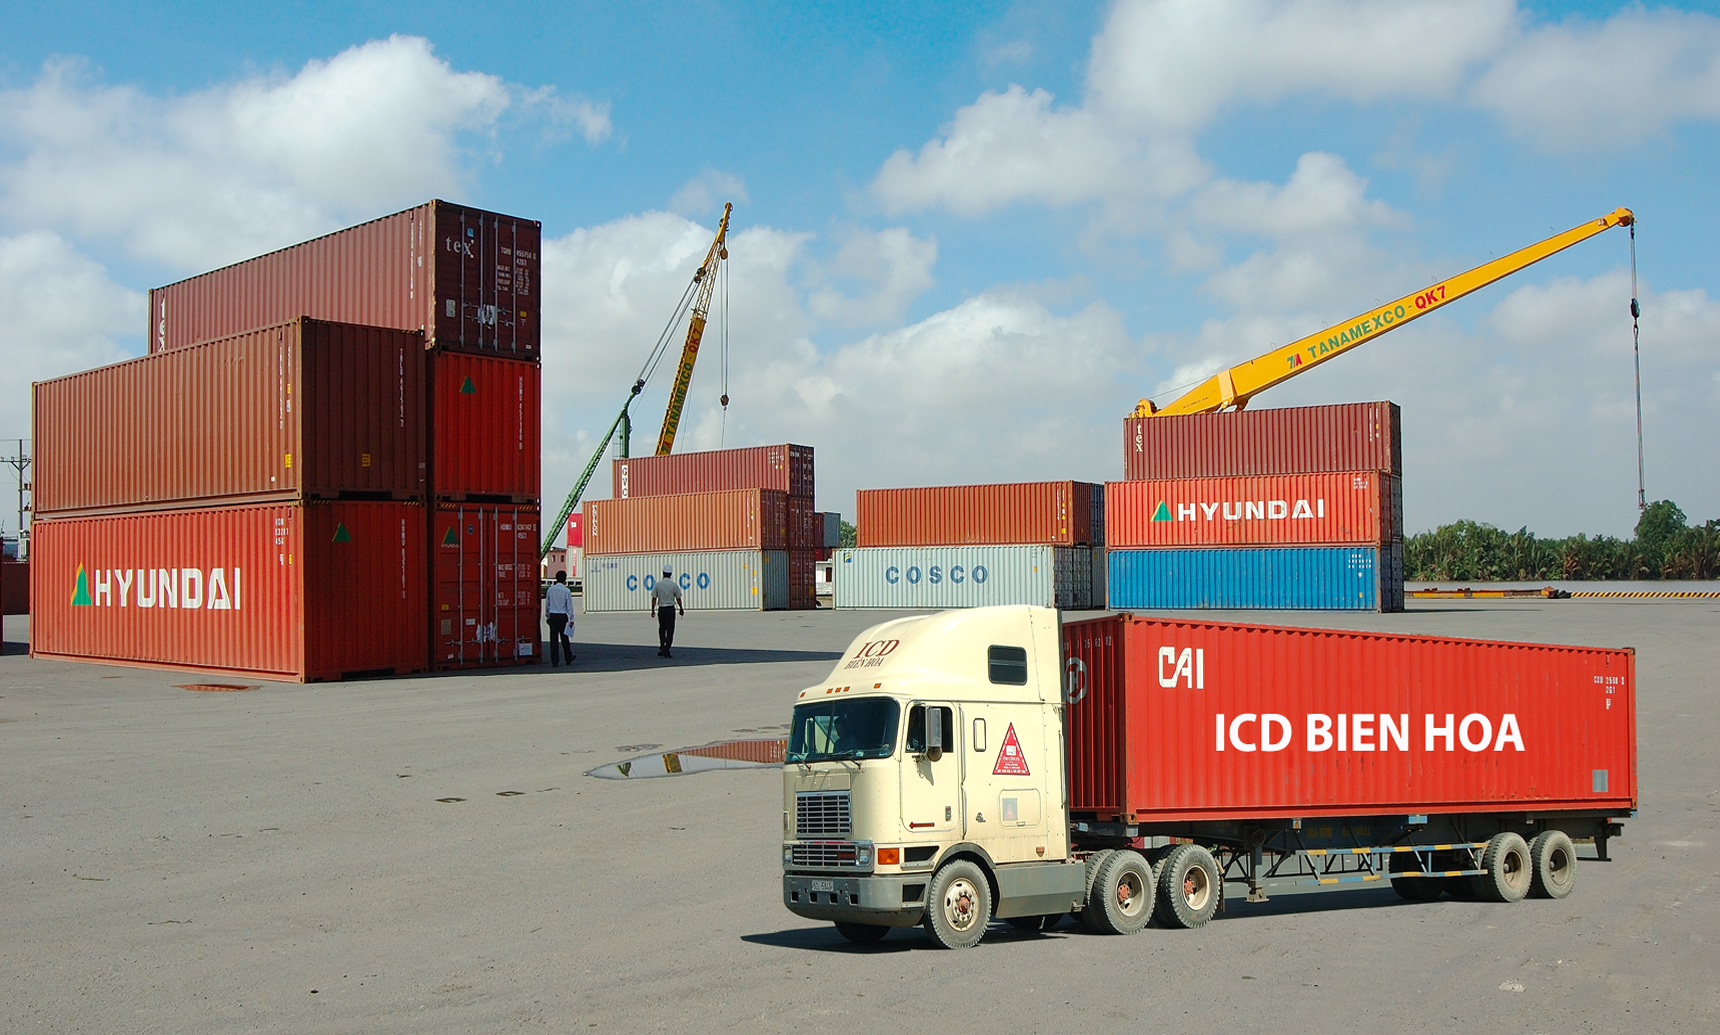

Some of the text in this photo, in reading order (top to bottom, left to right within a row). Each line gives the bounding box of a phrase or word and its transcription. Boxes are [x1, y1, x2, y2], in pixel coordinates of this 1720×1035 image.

[446, 236, 475, 259] tex
[1307, 305, 1406, 359] TANAMEXCO
[1415, 285, 1446, 310] QK7
[665, 361, 693, 437] TANAMEXCO
[687, 328, 701, 354] QK7
[1135, 423, 1143, 452] tex
[1177, 498, 1324, 521] HYUNDAI
[95, 566, 241, 611] HYUNDAI
[626, 571, 711, 592] COCO
[885, 564, 989, 585] COSCO
[853, 639, 900, 659] ICD
[1158, 646, 1204, 689] CAI
[1216, 712, 1526, 753] ICD BIEN HOA
